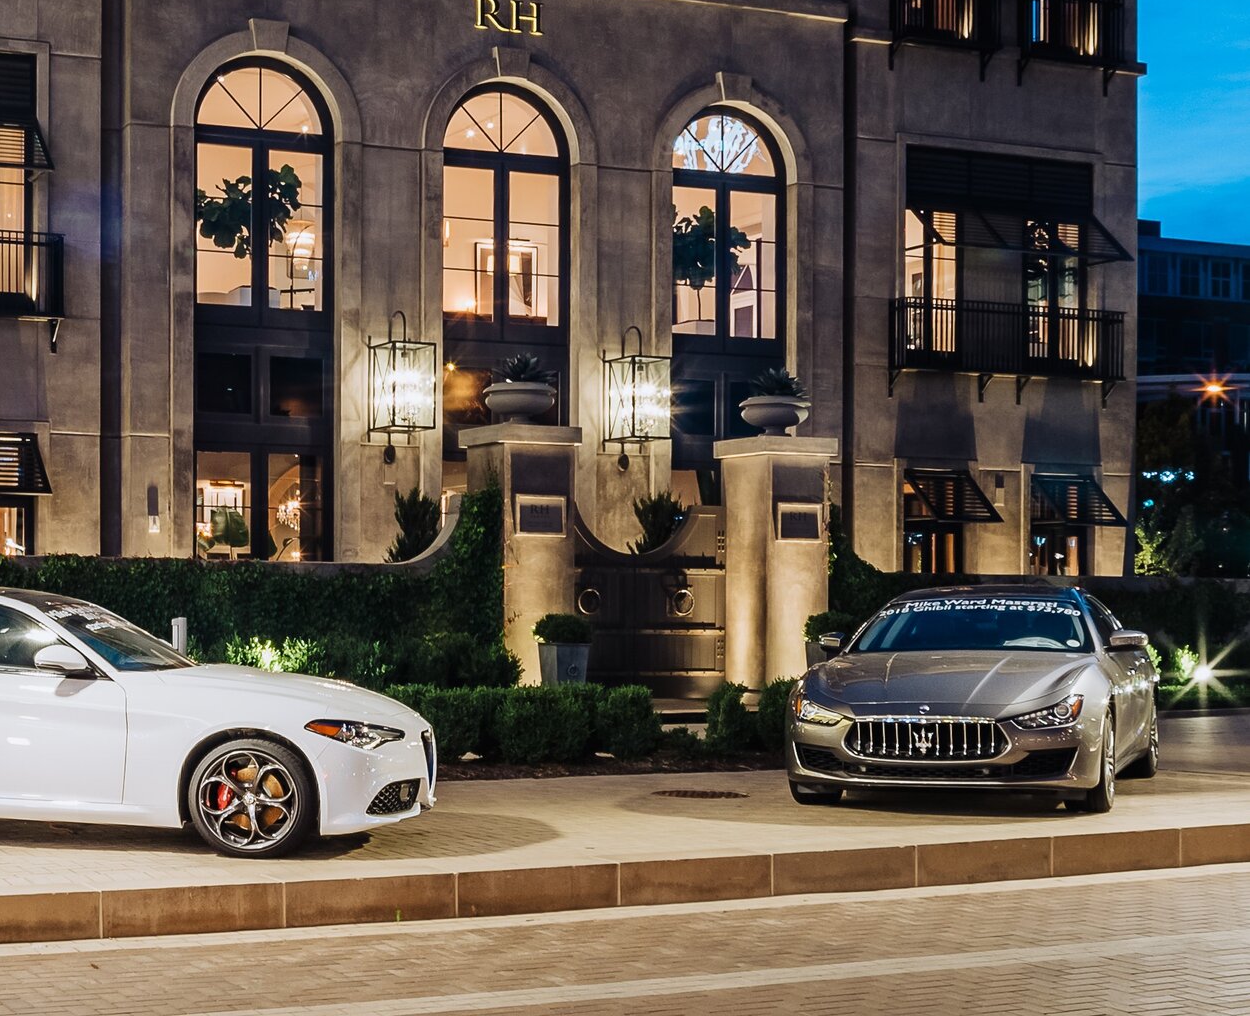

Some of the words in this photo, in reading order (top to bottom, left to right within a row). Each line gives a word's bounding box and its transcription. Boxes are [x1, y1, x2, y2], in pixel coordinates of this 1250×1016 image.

[905, 600, 941, 609] Mike
[944, 598, 987, 606] Ward
[991, 599, 1058, 608] Maserati
[879, 607, 909, 617] 2018
[955, 604, 1006, 612] starting
